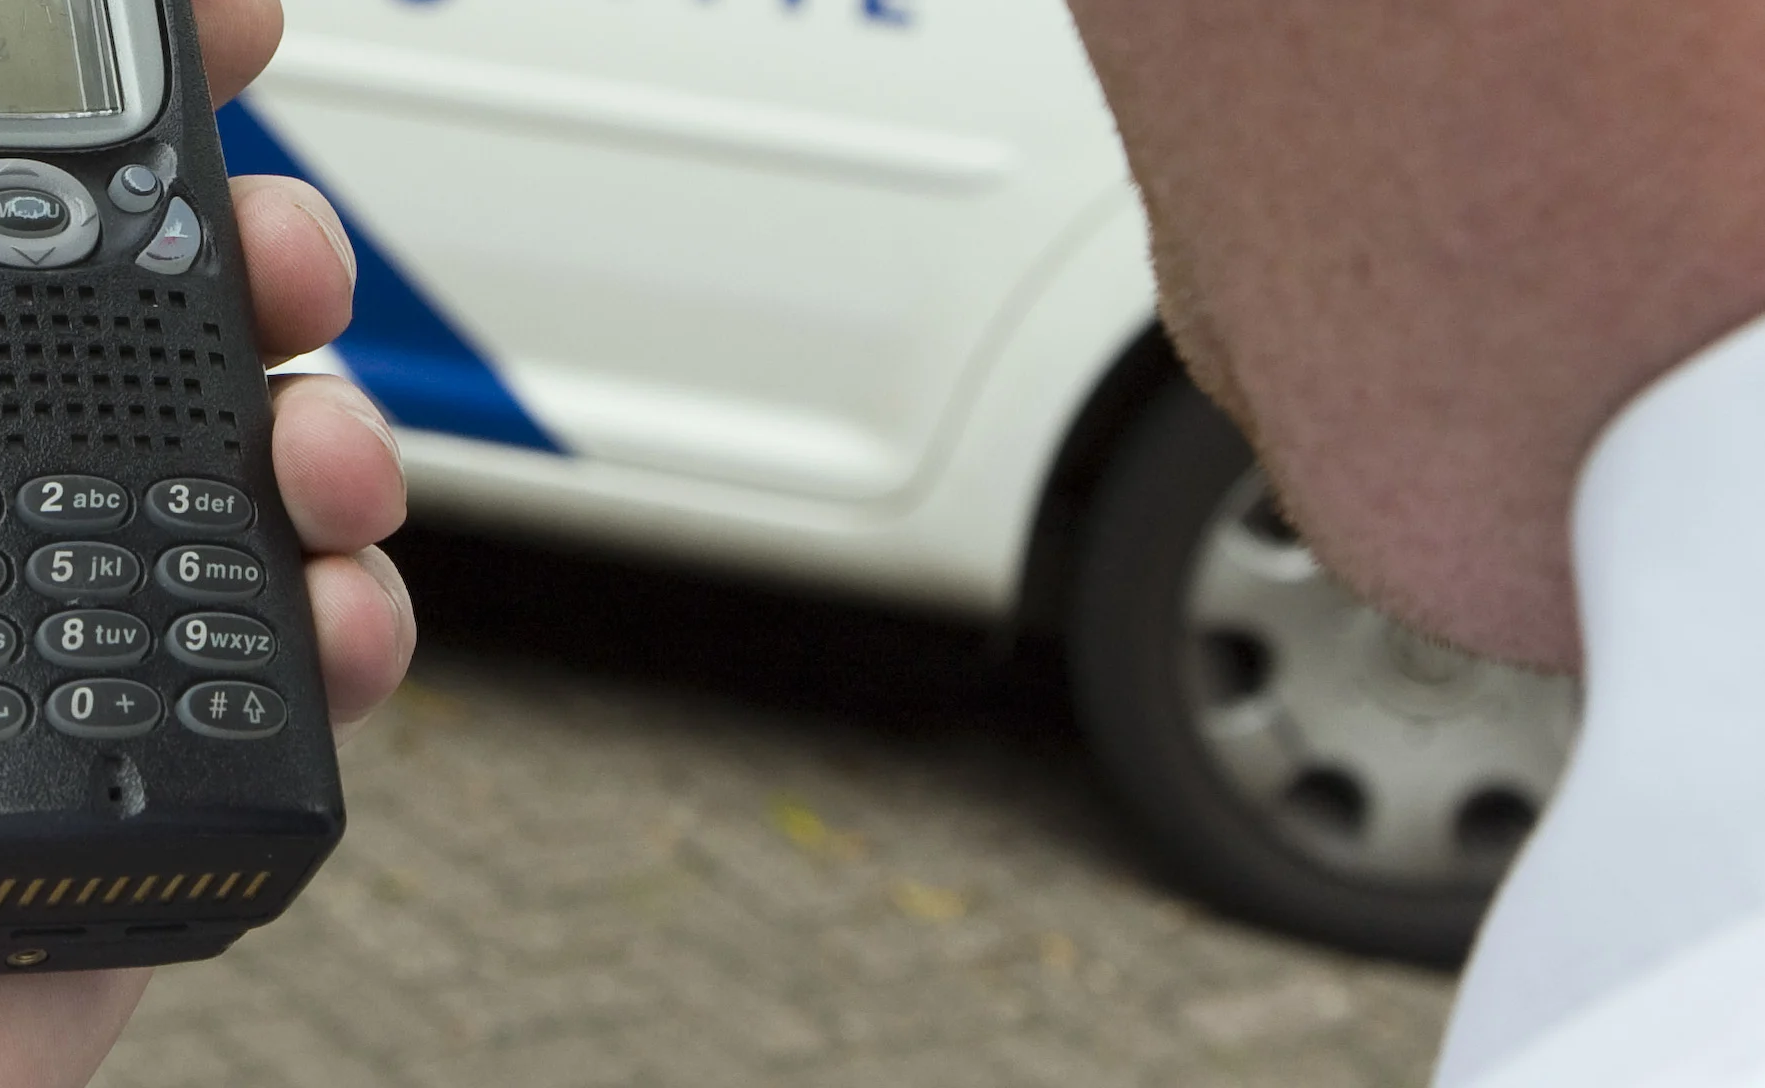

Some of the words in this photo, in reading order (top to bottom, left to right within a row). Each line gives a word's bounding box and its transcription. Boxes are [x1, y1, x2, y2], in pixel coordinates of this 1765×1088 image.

[40, 482, 64, 512] 2
[73, 488, 121, 509] abc
[51, 550, 74, 582] 5
[89, 556, 123, 582] jkl
[62, 618, 84, 650] 8
[95, 626, 137, 646] tuv
[71, 686, 94, 720] 0
